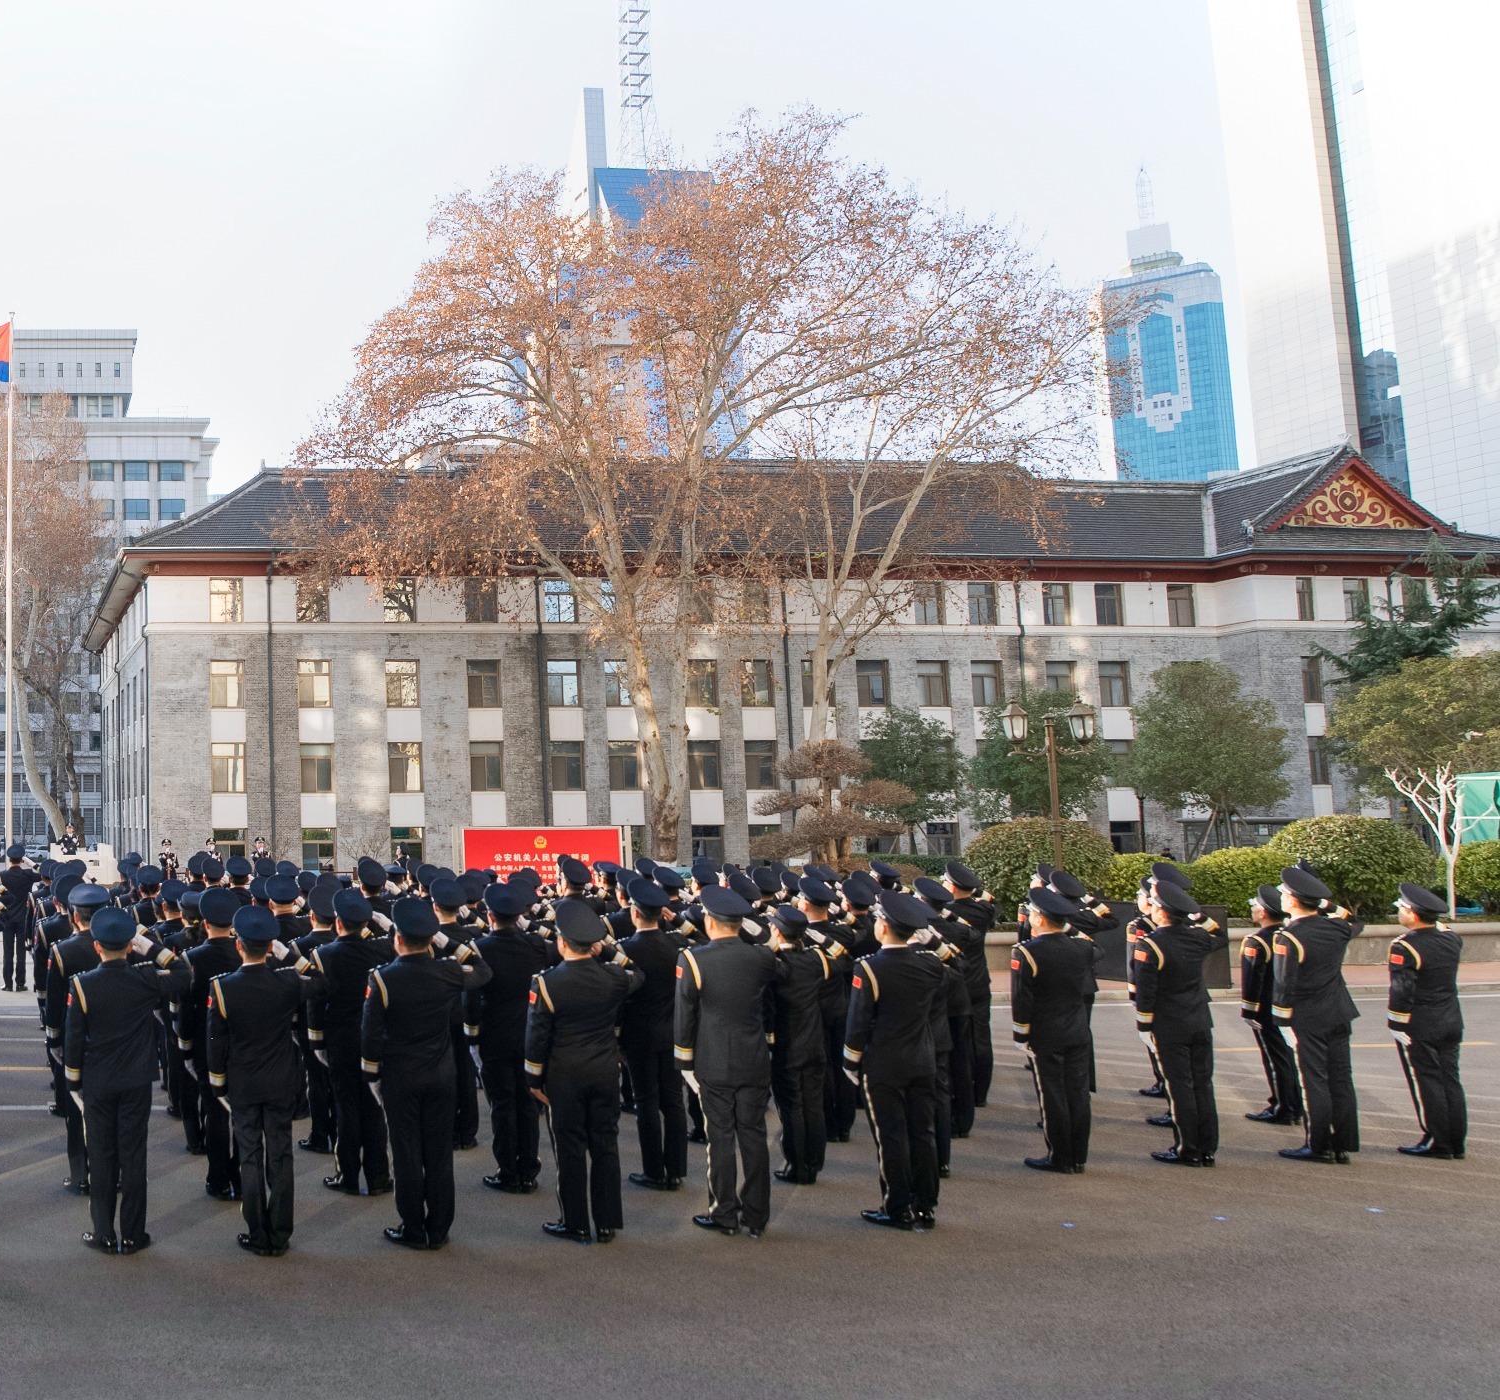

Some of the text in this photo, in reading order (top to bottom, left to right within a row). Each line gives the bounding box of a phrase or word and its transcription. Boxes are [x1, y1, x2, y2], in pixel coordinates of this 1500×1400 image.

[494, 853, 590, 862] 公安机关人民警誓词
